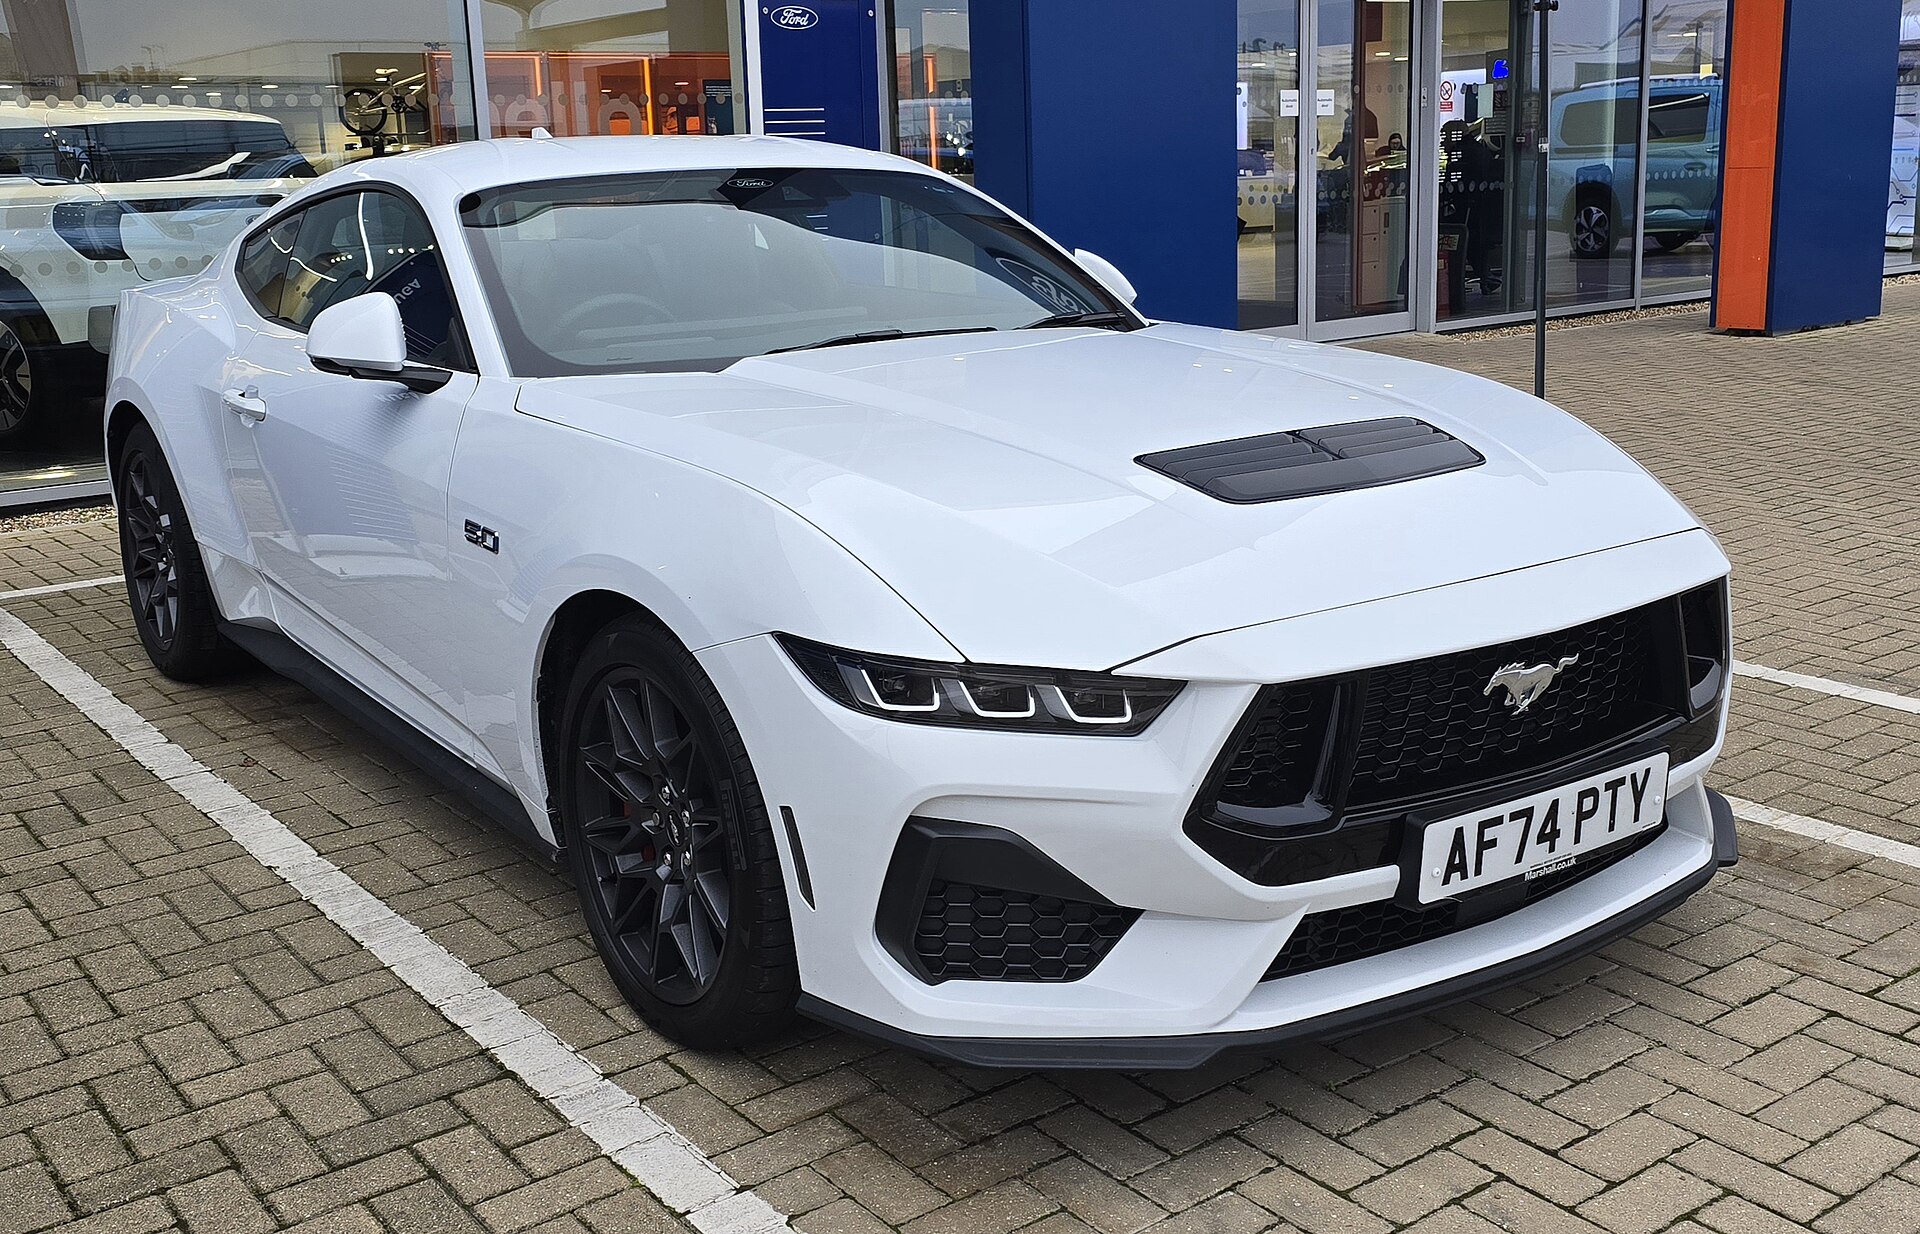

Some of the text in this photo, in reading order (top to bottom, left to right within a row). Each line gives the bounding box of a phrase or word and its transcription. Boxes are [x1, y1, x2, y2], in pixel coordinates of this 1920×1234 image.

[780, 8, 809, 26] Ford
[464, 518, 500, 555] 5.0
[1441, 767, 1652, 887] AF74 PTY
[1524, 857, 1577, 882] Marshall.co.uk
